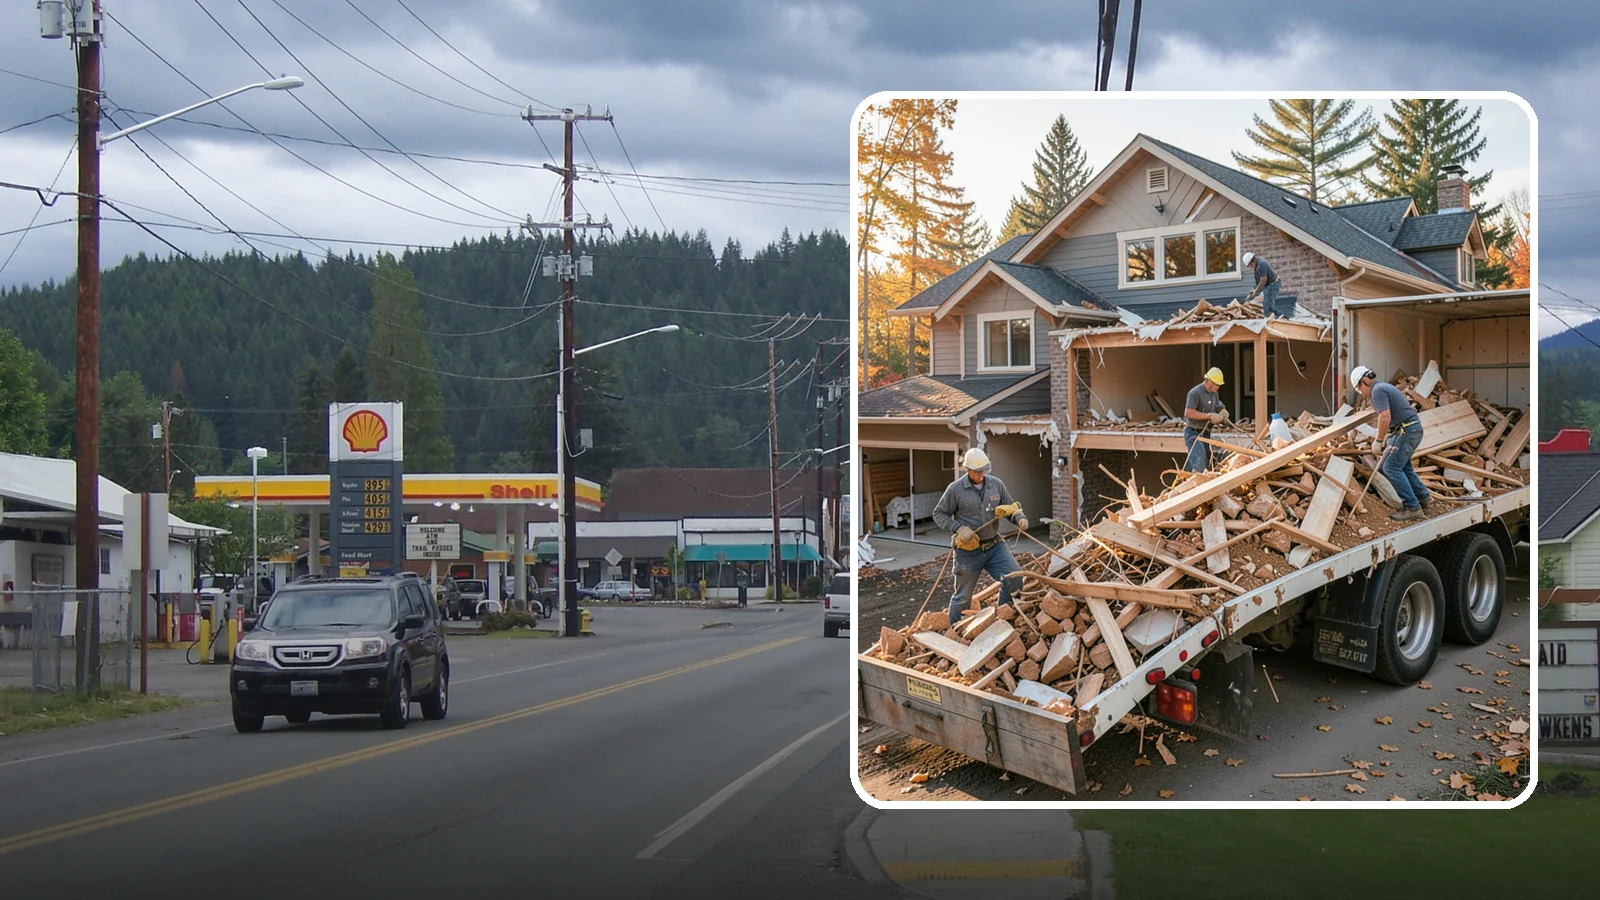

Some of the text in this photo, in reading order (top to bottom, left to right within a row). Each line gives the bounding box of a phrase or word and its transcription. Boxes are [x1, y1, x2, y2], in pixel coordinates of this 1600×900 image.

[366, 480, 383, 490] 395
[490, 484, 547, 499] Shell
[366, 494, 383, 504] 405
[366, 508, 383, 518] 415
[366, 522, 383, 533] 429
[1539, 642, 1567, 665] AID
[1539, 716, 1592, 738] WKENS
